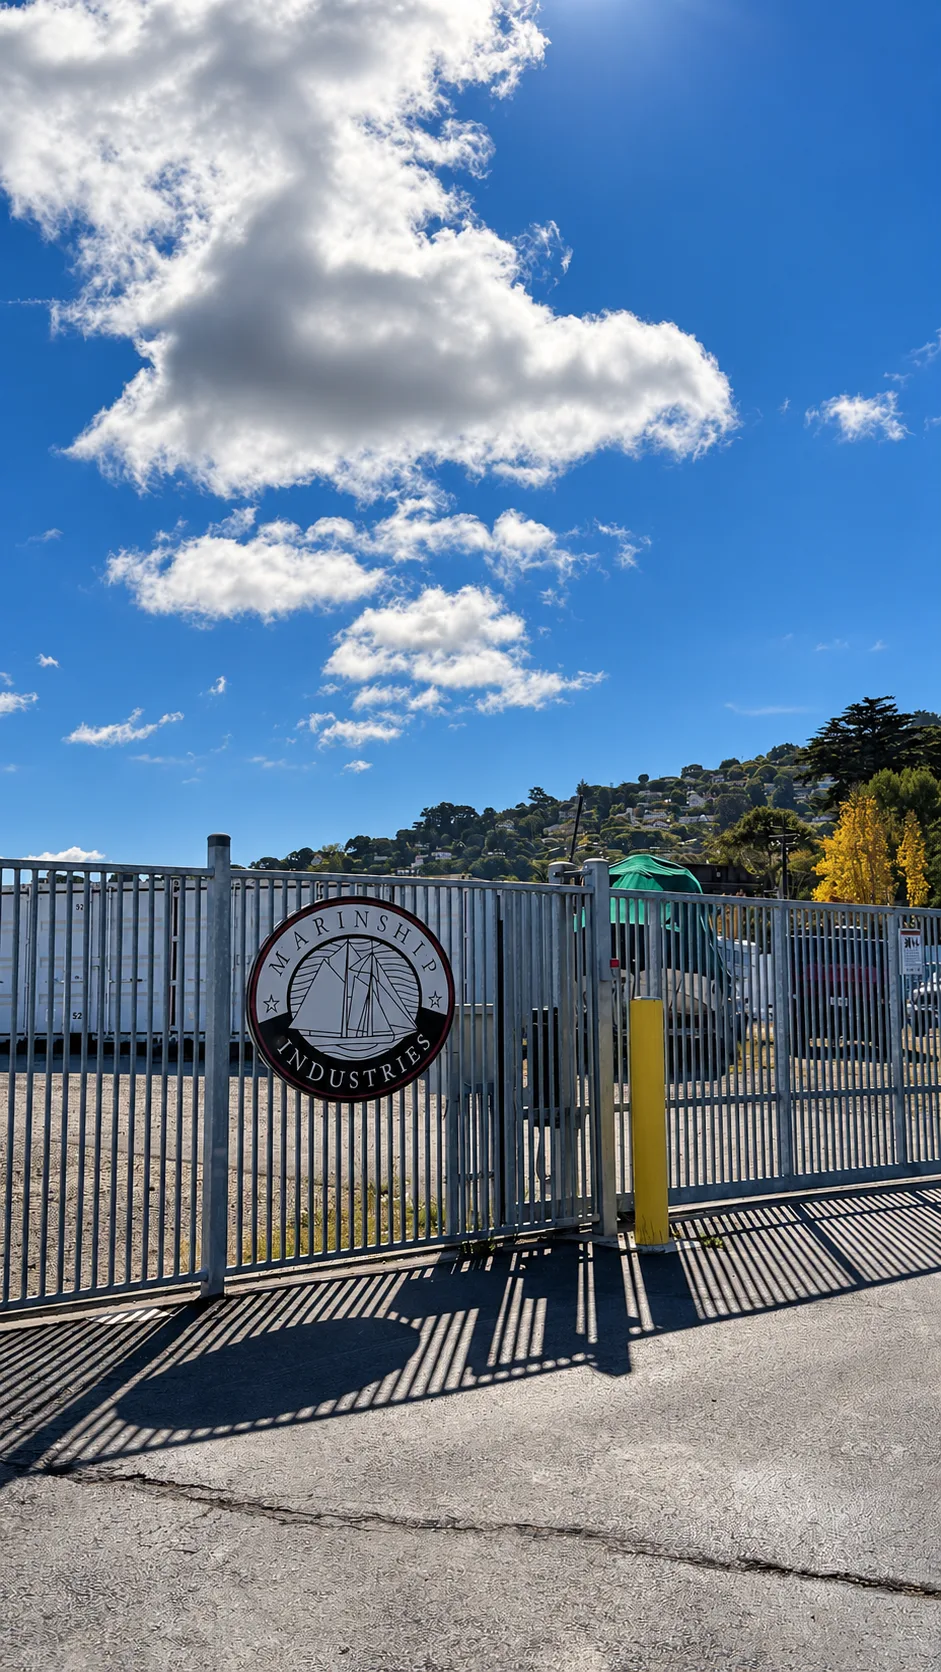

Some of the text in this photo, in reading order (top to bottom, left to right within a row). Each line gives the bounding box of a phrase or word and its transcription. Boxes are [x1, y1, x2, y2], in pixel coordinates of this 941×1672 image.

[268, 910, 437, 976] MARINSHIP
[72, 1011, 83, 1020] 52
[277, 1034, 431, 1089] INDUSTRIES
